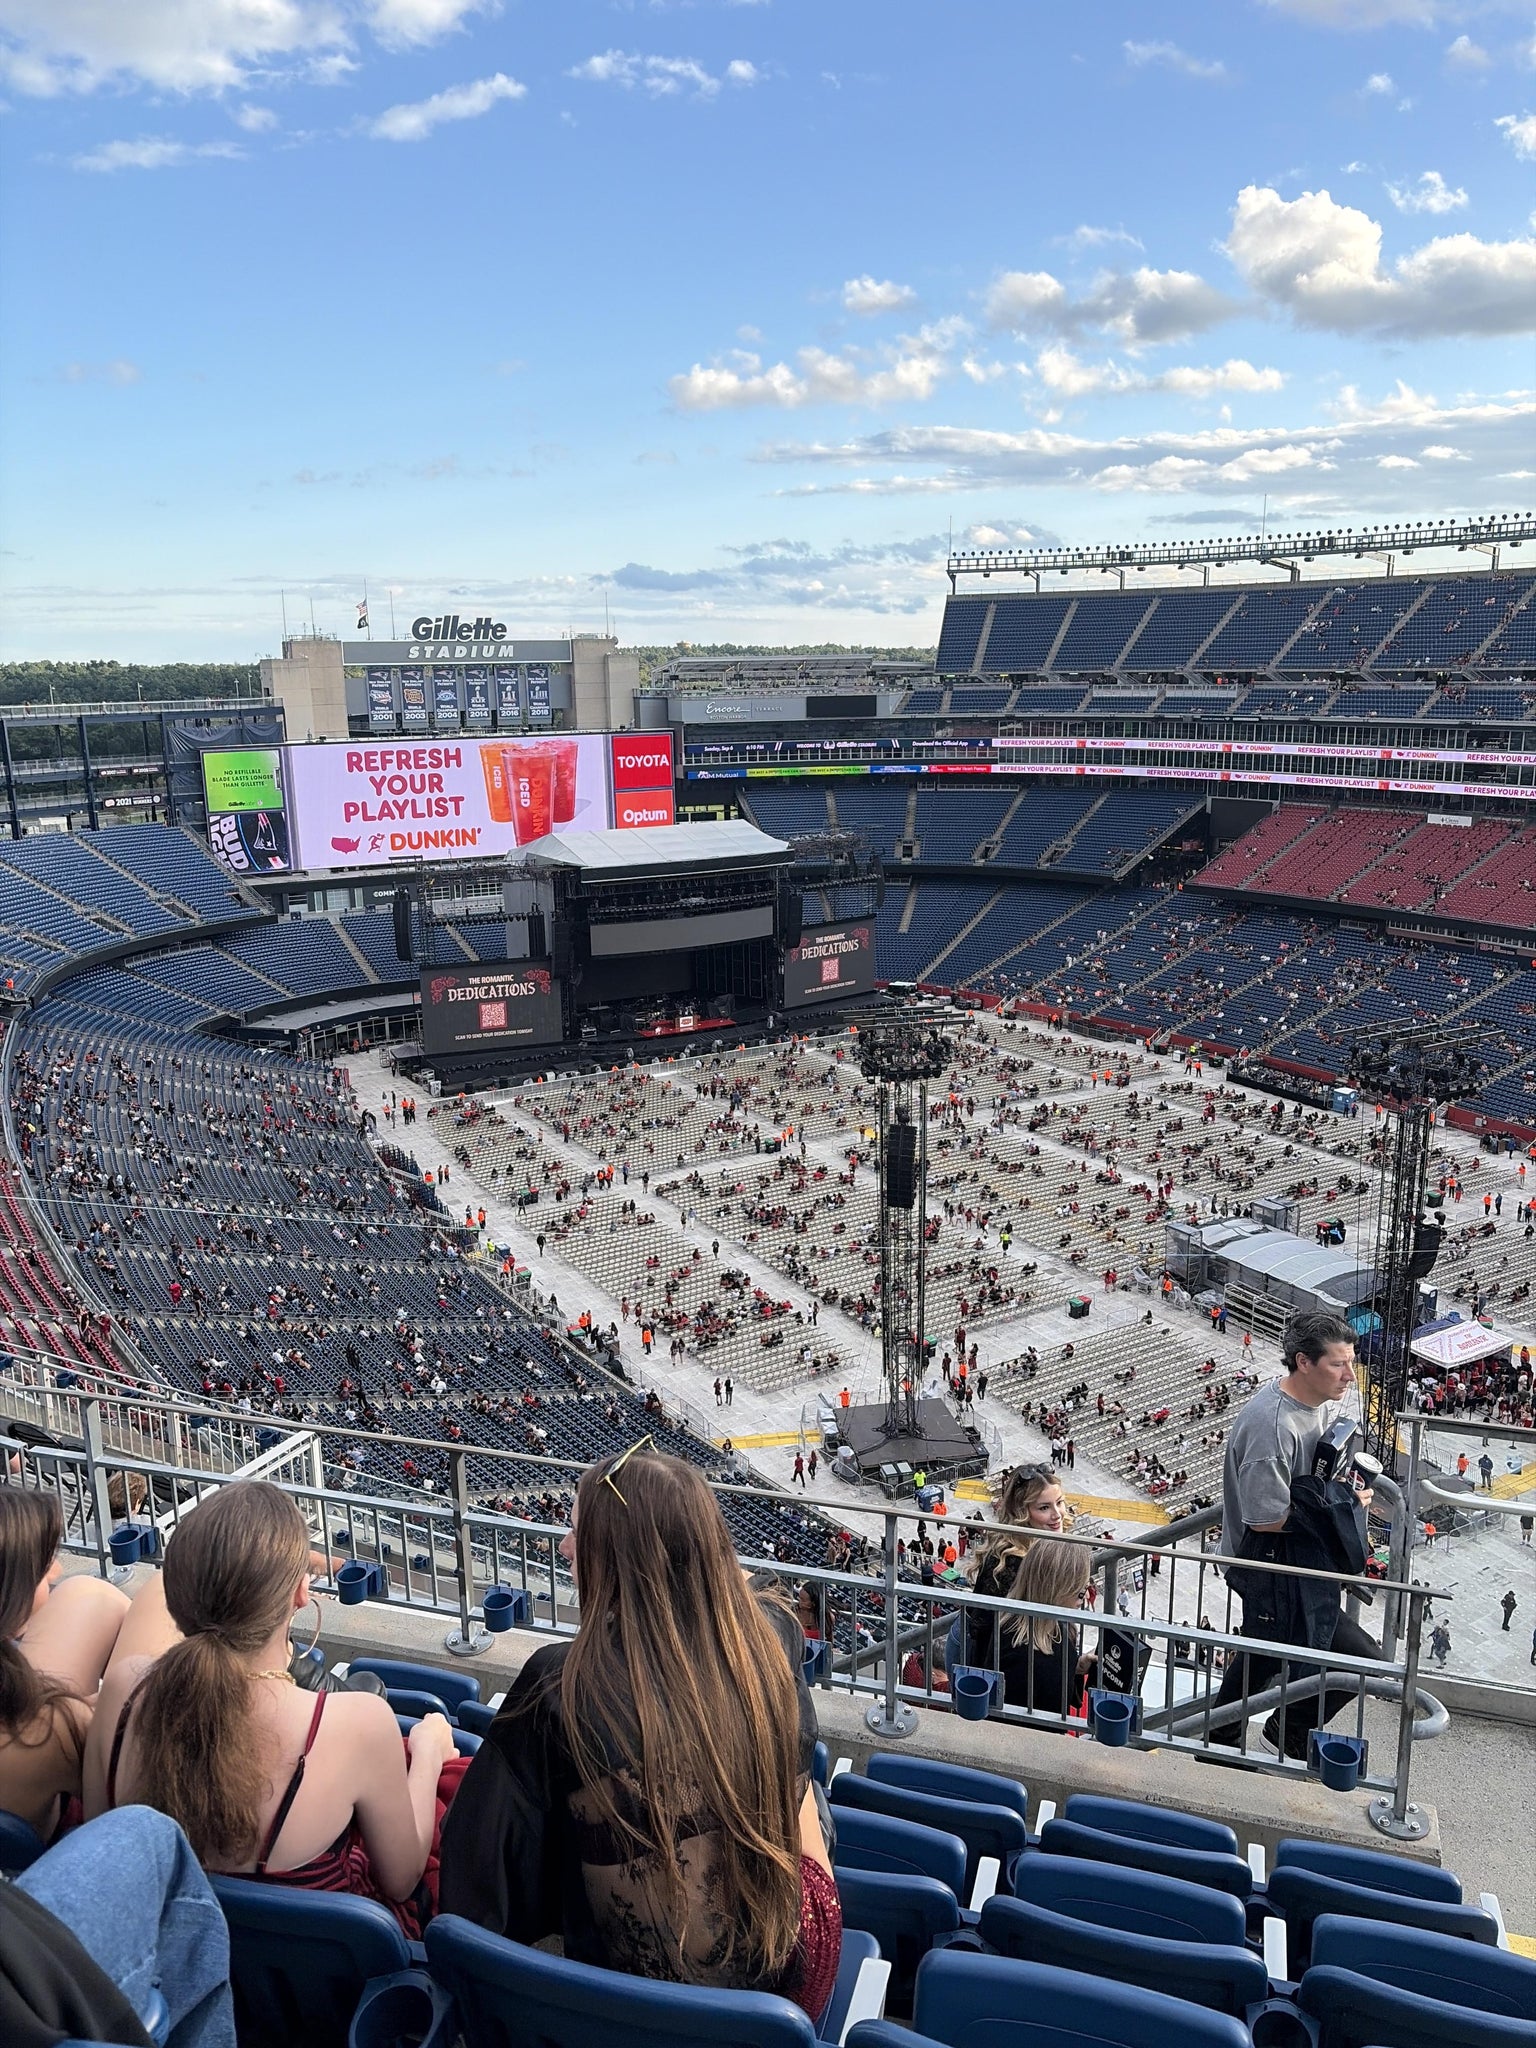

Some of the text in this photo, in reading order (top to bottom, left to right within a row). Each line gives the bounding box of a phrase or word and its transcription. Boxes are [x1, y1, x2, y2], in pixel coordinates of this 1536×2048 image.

[411, 615, 507, 641] Gillette
[408, 645, 514, 658] STADIUM
[706, 701, 750, 714] Encore
[346, 748, 461, 772] REFRESH
[618, 754, 669, 768] TOYOTA
[369, 774, 444, 796] YOUR
[493, 766, 501, 789] ICED
[116, 798, 132, 806] 2021
[519, 778, 530, 807] ICED
[1498, 788, 1518, 796] YOUR
[344, 796, 464, 823] PLAYLIST
[531, 778, 544, 835] DUNKIN'
[623, 809, 667, 825] Optum
[220, 815, 249, 869] BUD
[390, 828, 482, 850] DUNKIN'
[824, 933, 846, 942] ROMANTIC
[802, 939, 859, 960] DEDICATIONS
[468, 974, 514, 985] THE ROMANTIC
[448, 982, 536, 1002] DEDICATIONS
[1315, 1458, 1328, 1478] RIOTS
[1105, 1653, 1121, 1671] Gillette
[1102, 1666, 1123, 1688] PCORN
